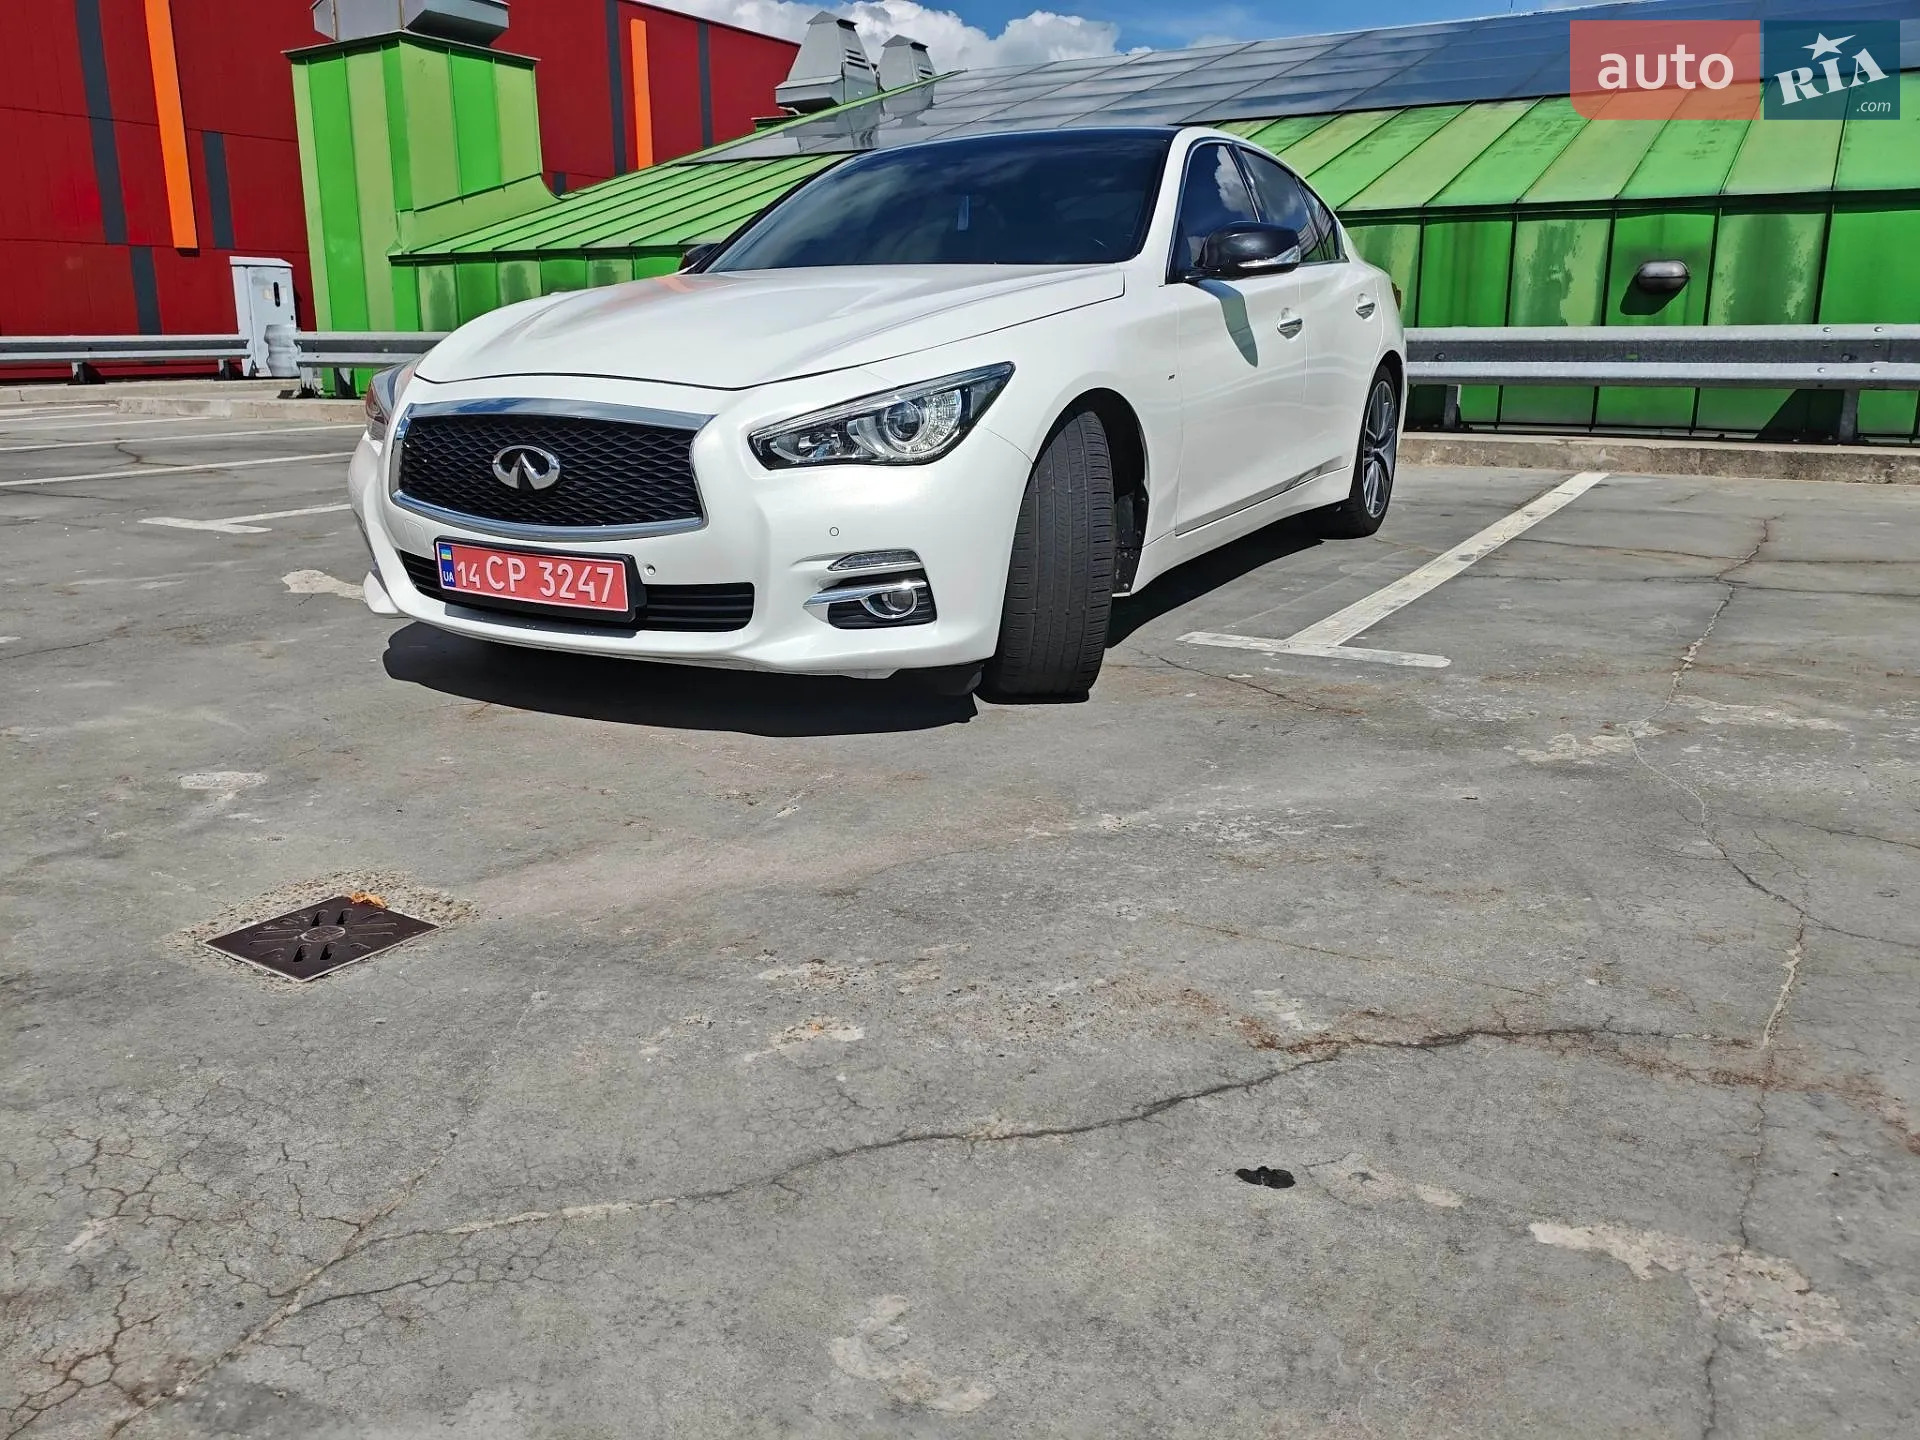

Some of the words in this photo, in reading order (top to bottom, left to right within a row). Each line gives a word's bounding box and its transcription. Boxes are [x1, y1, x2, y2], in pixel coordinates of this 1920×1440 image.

[443, 570, 455, 583] UA
[457, 561, 481, 589] 14
[485, 555, 526, 592] CP
[538, 561, 614, 603] 3247
